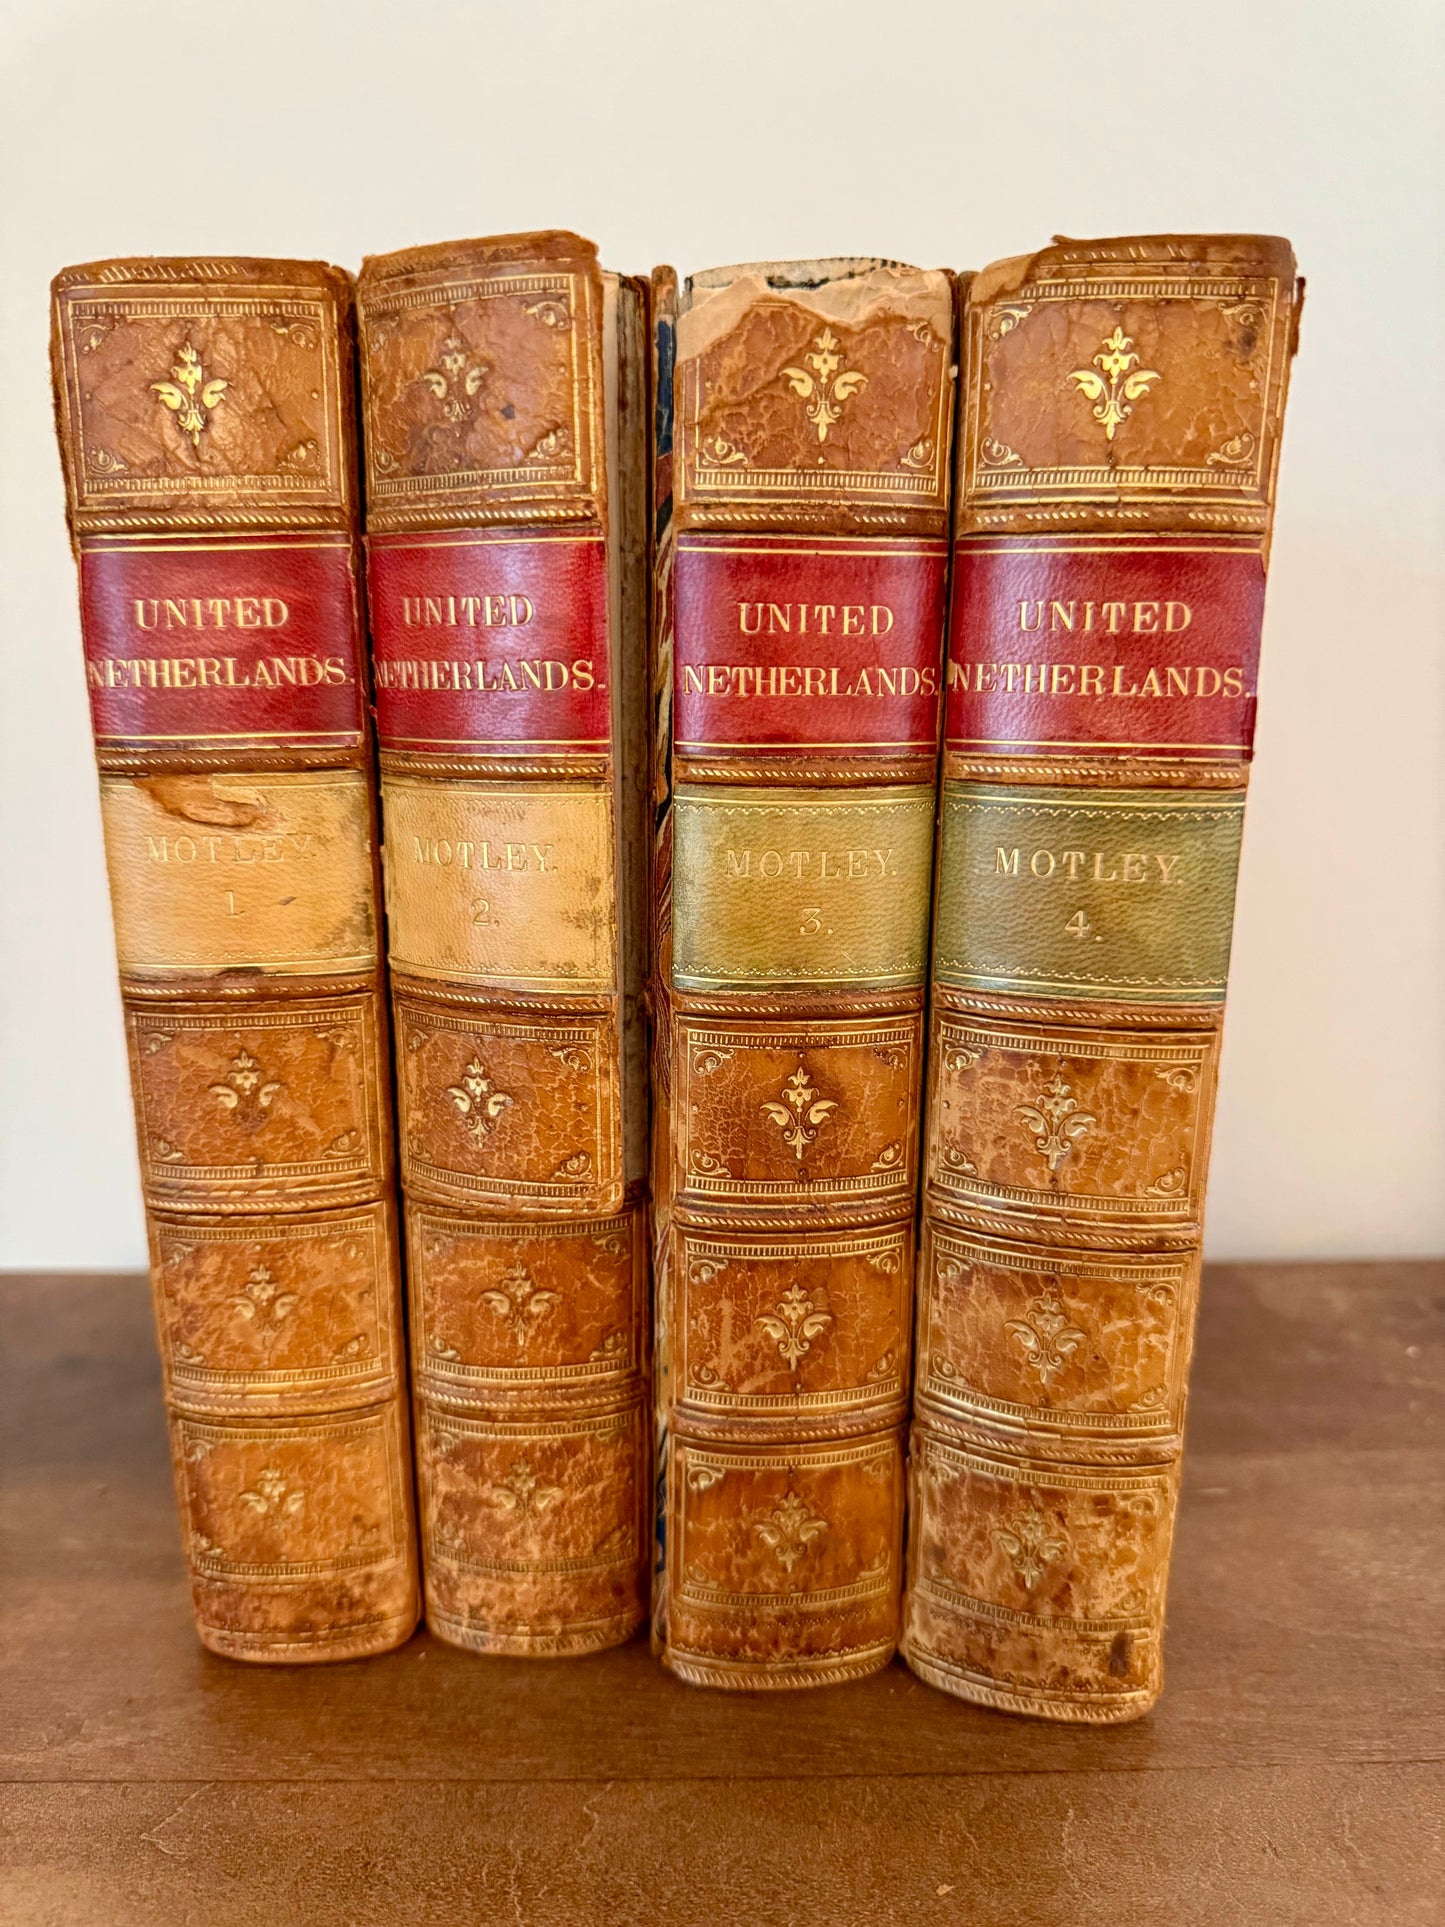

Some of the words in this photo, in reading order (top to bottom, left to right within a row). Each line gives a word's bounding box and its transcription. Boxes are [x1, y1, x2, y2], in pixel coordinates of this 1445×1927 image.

[135, 597, 289, 630] UNITED
[403, 595, 534, 627] UNITED
[737, 602, 894, 635] UNITED
[1019, 600, 1193, 633] UNITED
[88, 656, 355, 689] NETHERLANDS.
[376, 659, 606, 692] NETHERLANDS.
[682, 664, 939, 697] NETHERLANDS.
[952, 663, 1251, 699] NETHERLANDS.
[414, 836, 558, 872] MOTLEY.
[726, 848, 897, 878] MOTLEY.
[994, 847, 1184, 884] MOTLEY.
[800, 907, 834, 935] 3.
[1064, 910, 1102, 941] 4.
